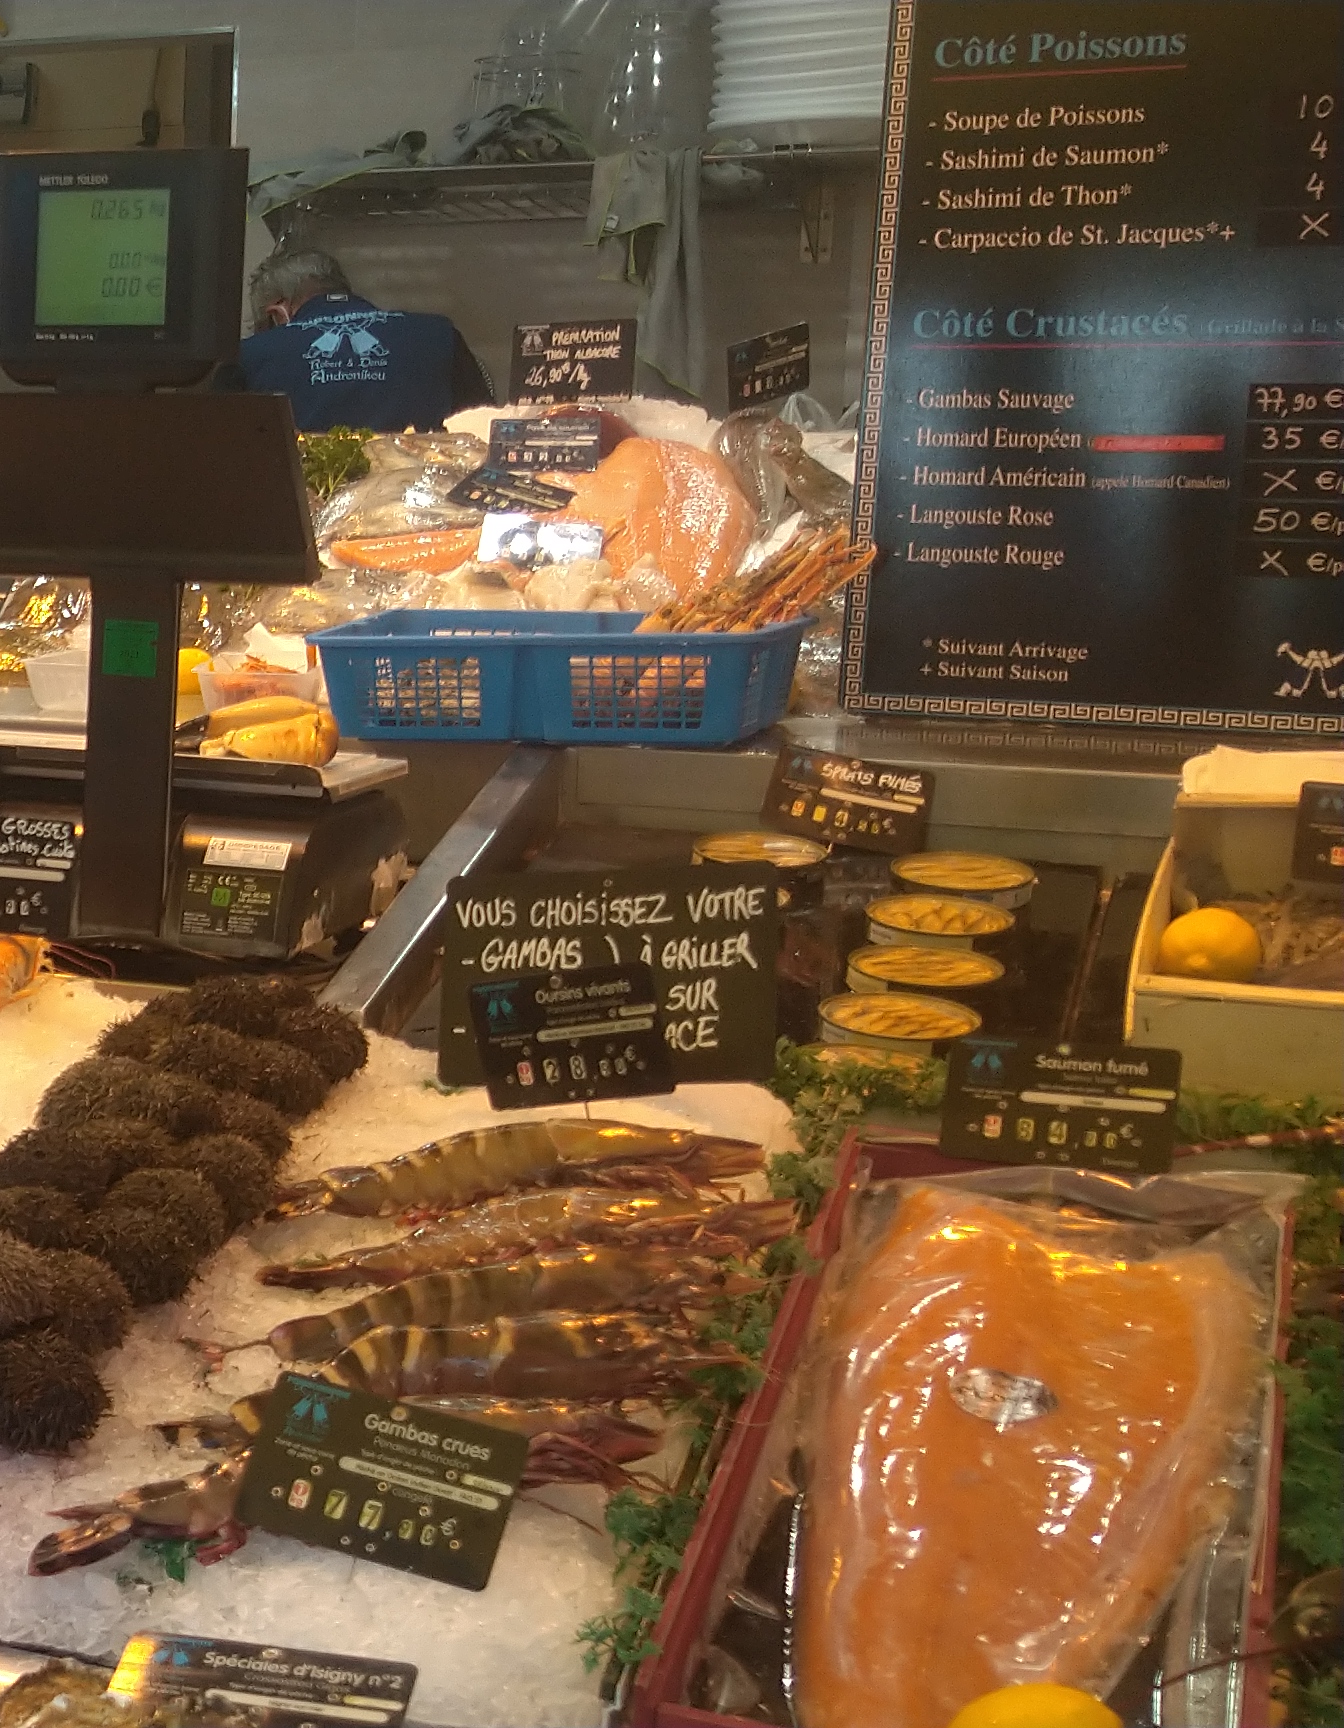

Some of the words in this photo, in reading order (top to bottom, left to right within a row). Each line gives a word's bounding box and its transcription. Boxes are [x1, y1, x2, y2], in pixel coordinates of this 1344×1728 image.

[934, 35, 1017, 69] Côté
[1029, 30, 1188, 64] Poissons
[944, 110, 1009, 135] Soupe
[1016, 106, 1041, 128] de
[1048, 104, 1145, 128] Poissons
[940, 145, 1026, 171] Sashimi
[1032, 146, 1058, 168] de
[937, 186, 1022, 211] Sashimi
[1029, 185, 1054, 207] de
[934, 225, 1042, 254] Carpaccio
[1048, 224, 1074, 246] de
[1080, 224, 1110, 246] St.
[912, 307, 996, 339] Côté
[1006, 304, 1188, 339] Crustacés
[918, 388, 991, 409] Gambas
[997, 388, 1075, 413] Sauvage
[916, 427, 989, 448] Homard
[994, 427, 1082, 452] Européen
[1261, 426, 1304, 450] 35
[913, 465, 986, 488] Homard
[989, 466, 1086, 488] Américain
[910, 503, 1002, 528] Langouste
[1008, 505, 1054, 526] Rose
[1253, 507, 1301, 533] 50
[907, 541, 999, 568] Langouste
[1004, 543, 1064, 570] Rouge
[938, 637, 1004, 657] Suivant
[1009, 639, 1088, 661] Arrivage
[937, 661, 1003, 680] Suivant
[1009, 662, 1070, 682] Saison
[1, 818, 71, 840] GROSSES
[456, 898, 517, 928] VOUS
[687, 887, 766, 924] VOTRE
[481, 936, 583, 973] GAMBAS
[534, 987, 584, 1004] Oursins
[665, 977, 719, 1012] SUR
[1036, 1054, 1103, 1073] Saumon
[1106, 1058, 1150, 1077] fumé
[364, 1412, 439, 1448] Gambas
[442, 1436, 492, 1462] crues
[203, 1650, 290, 1678] Spéciales
[293, 1660, 366, 1691] d'Isigny
[368, 1671, 405, 1692] n°2
